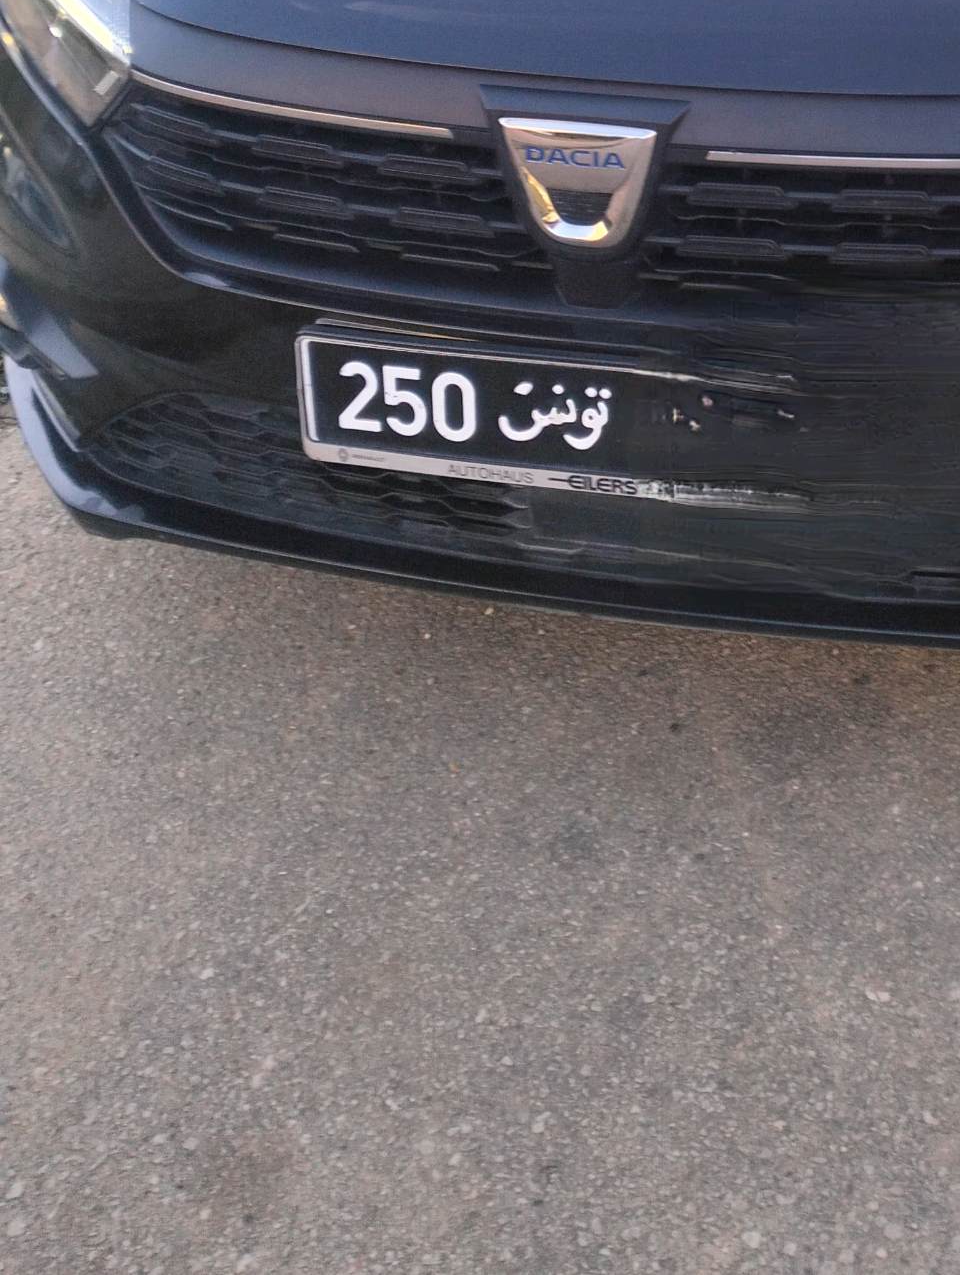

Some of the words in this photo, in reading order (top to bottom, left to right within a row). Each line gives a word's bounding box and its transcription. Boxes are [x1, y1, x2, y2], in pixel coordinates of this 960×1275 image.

[524, 145, 625, 170] DACIA
[338, 361, 477, 442] 250
[498, 381, 612, 450] تونس
[448, 464, 535, 485] AUTOHAUS
[567, 475, 639, 495] EILERS
